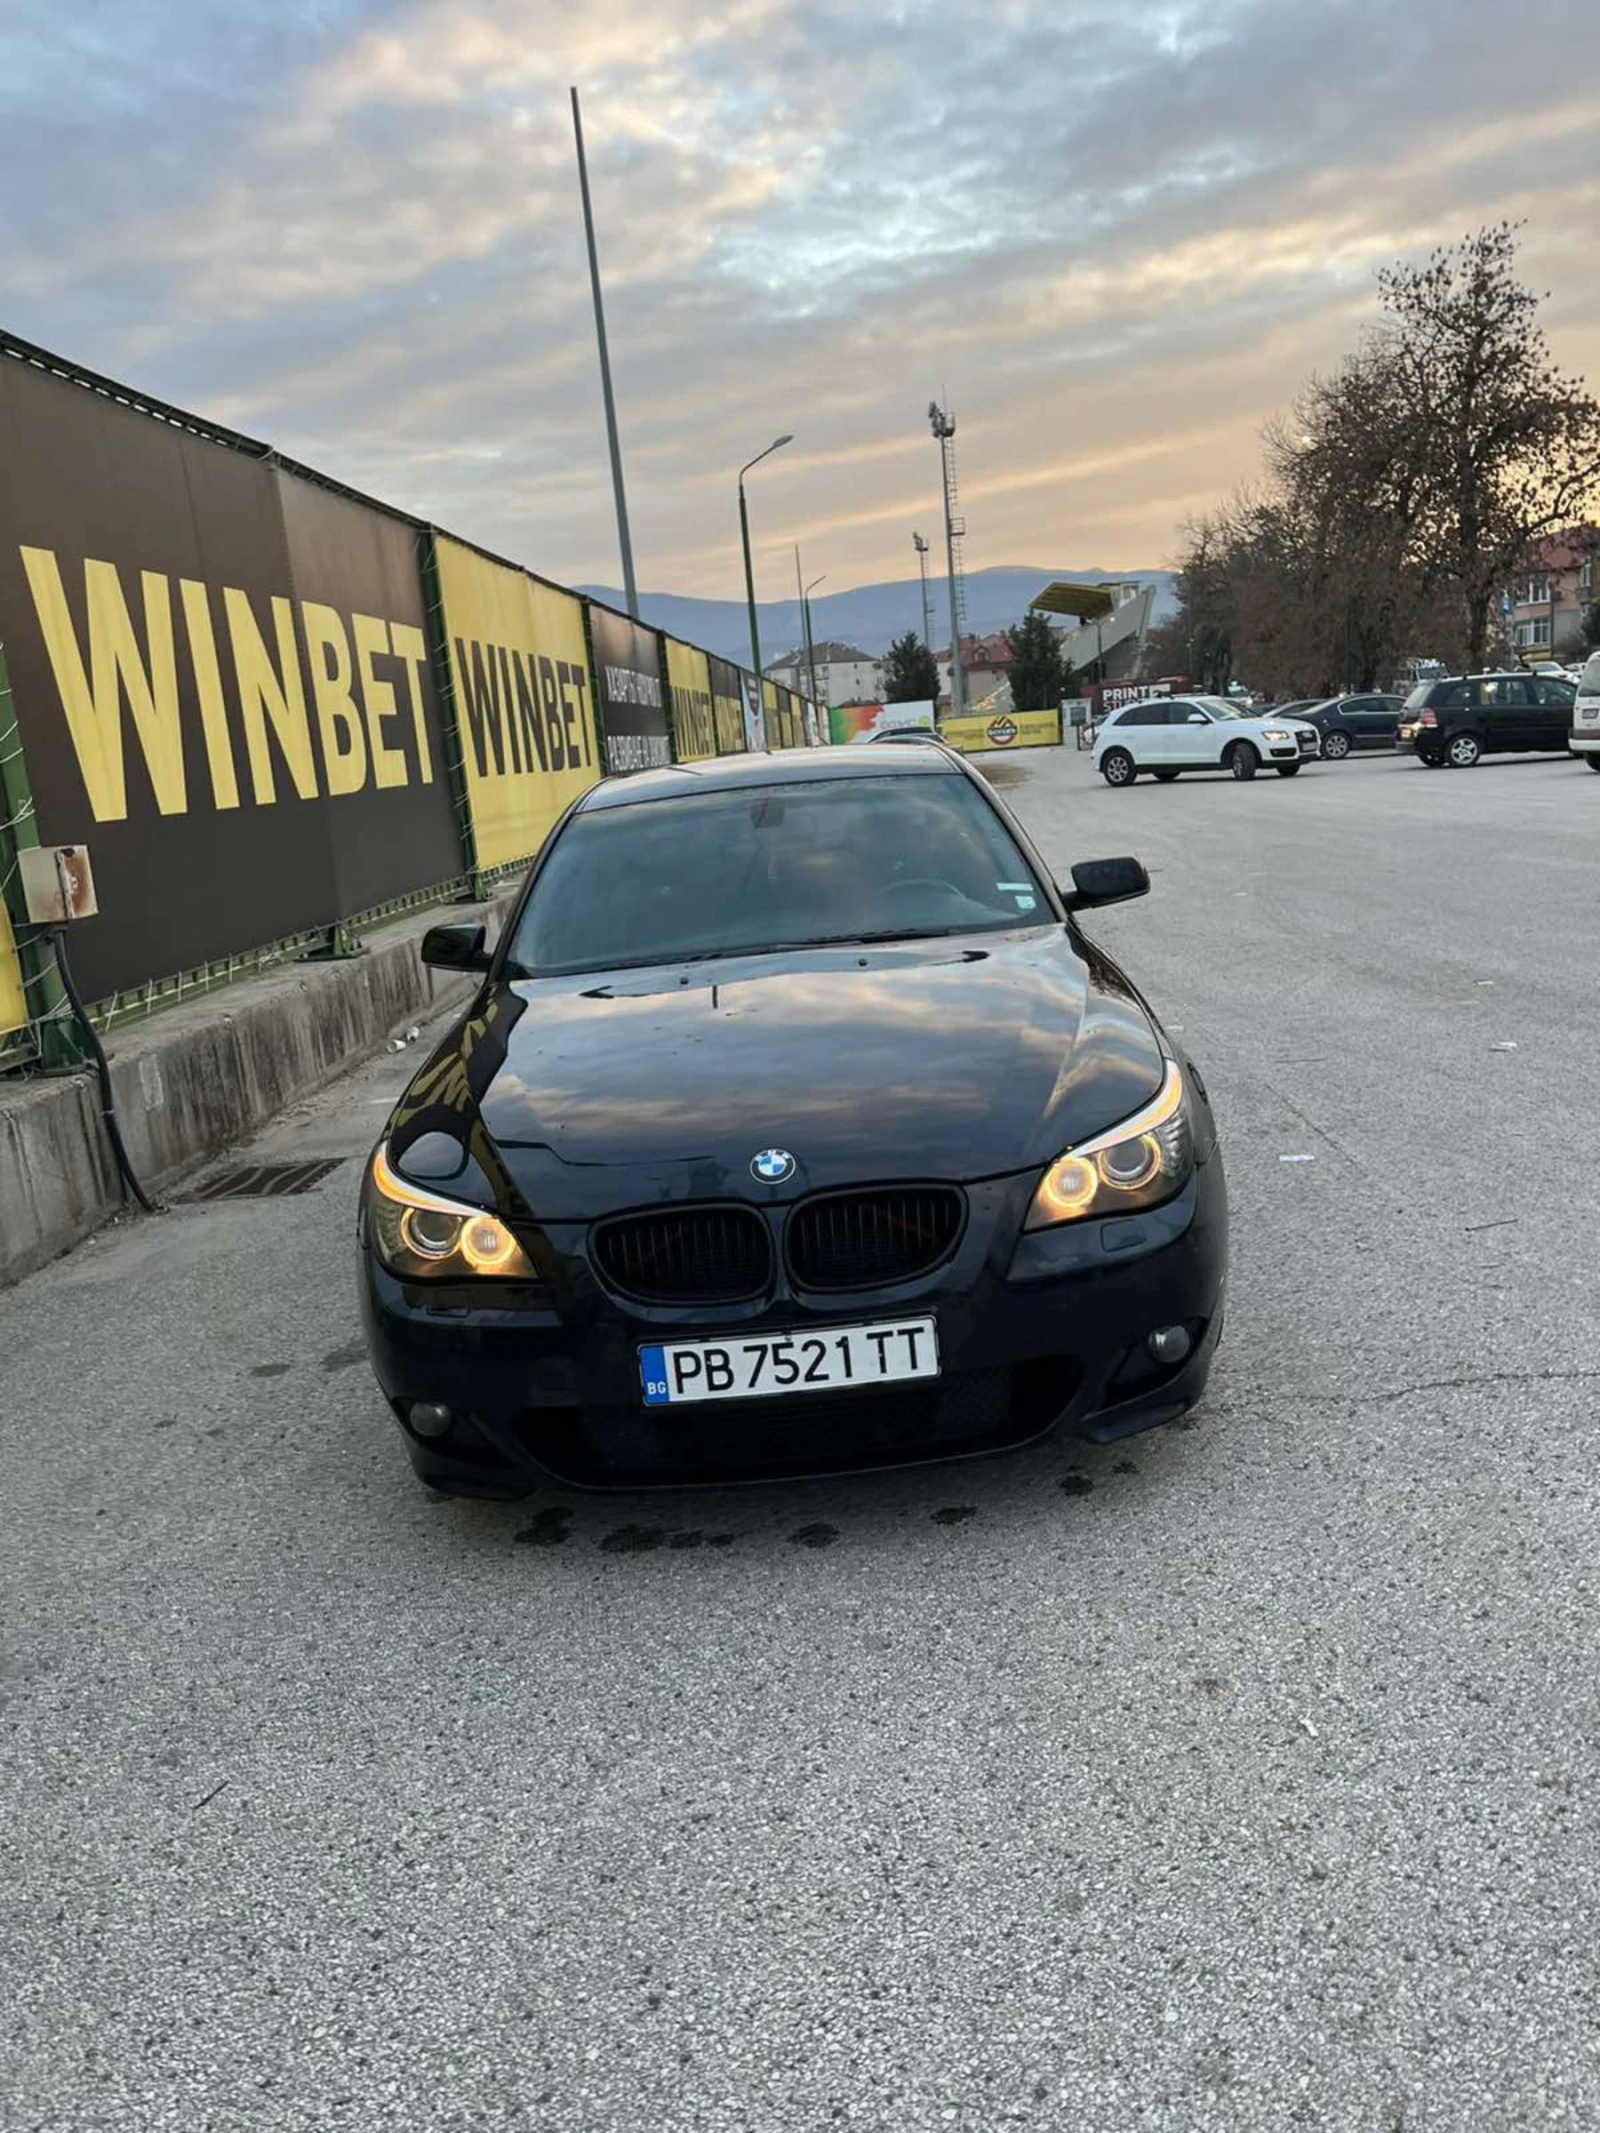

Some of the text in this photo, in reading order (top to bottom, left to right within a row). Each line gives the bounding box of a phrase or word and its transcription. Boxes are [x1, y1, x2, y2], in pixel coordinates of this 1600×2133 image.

[19, 545, 434, 823] WINBET
[454, 637, 592, 778] WINBET
[1103, 685, 1148, 701] PRINT
[647, 1381, 666, 1395] BG
[672, 1327, 924, 1394] PB 7521 TT
